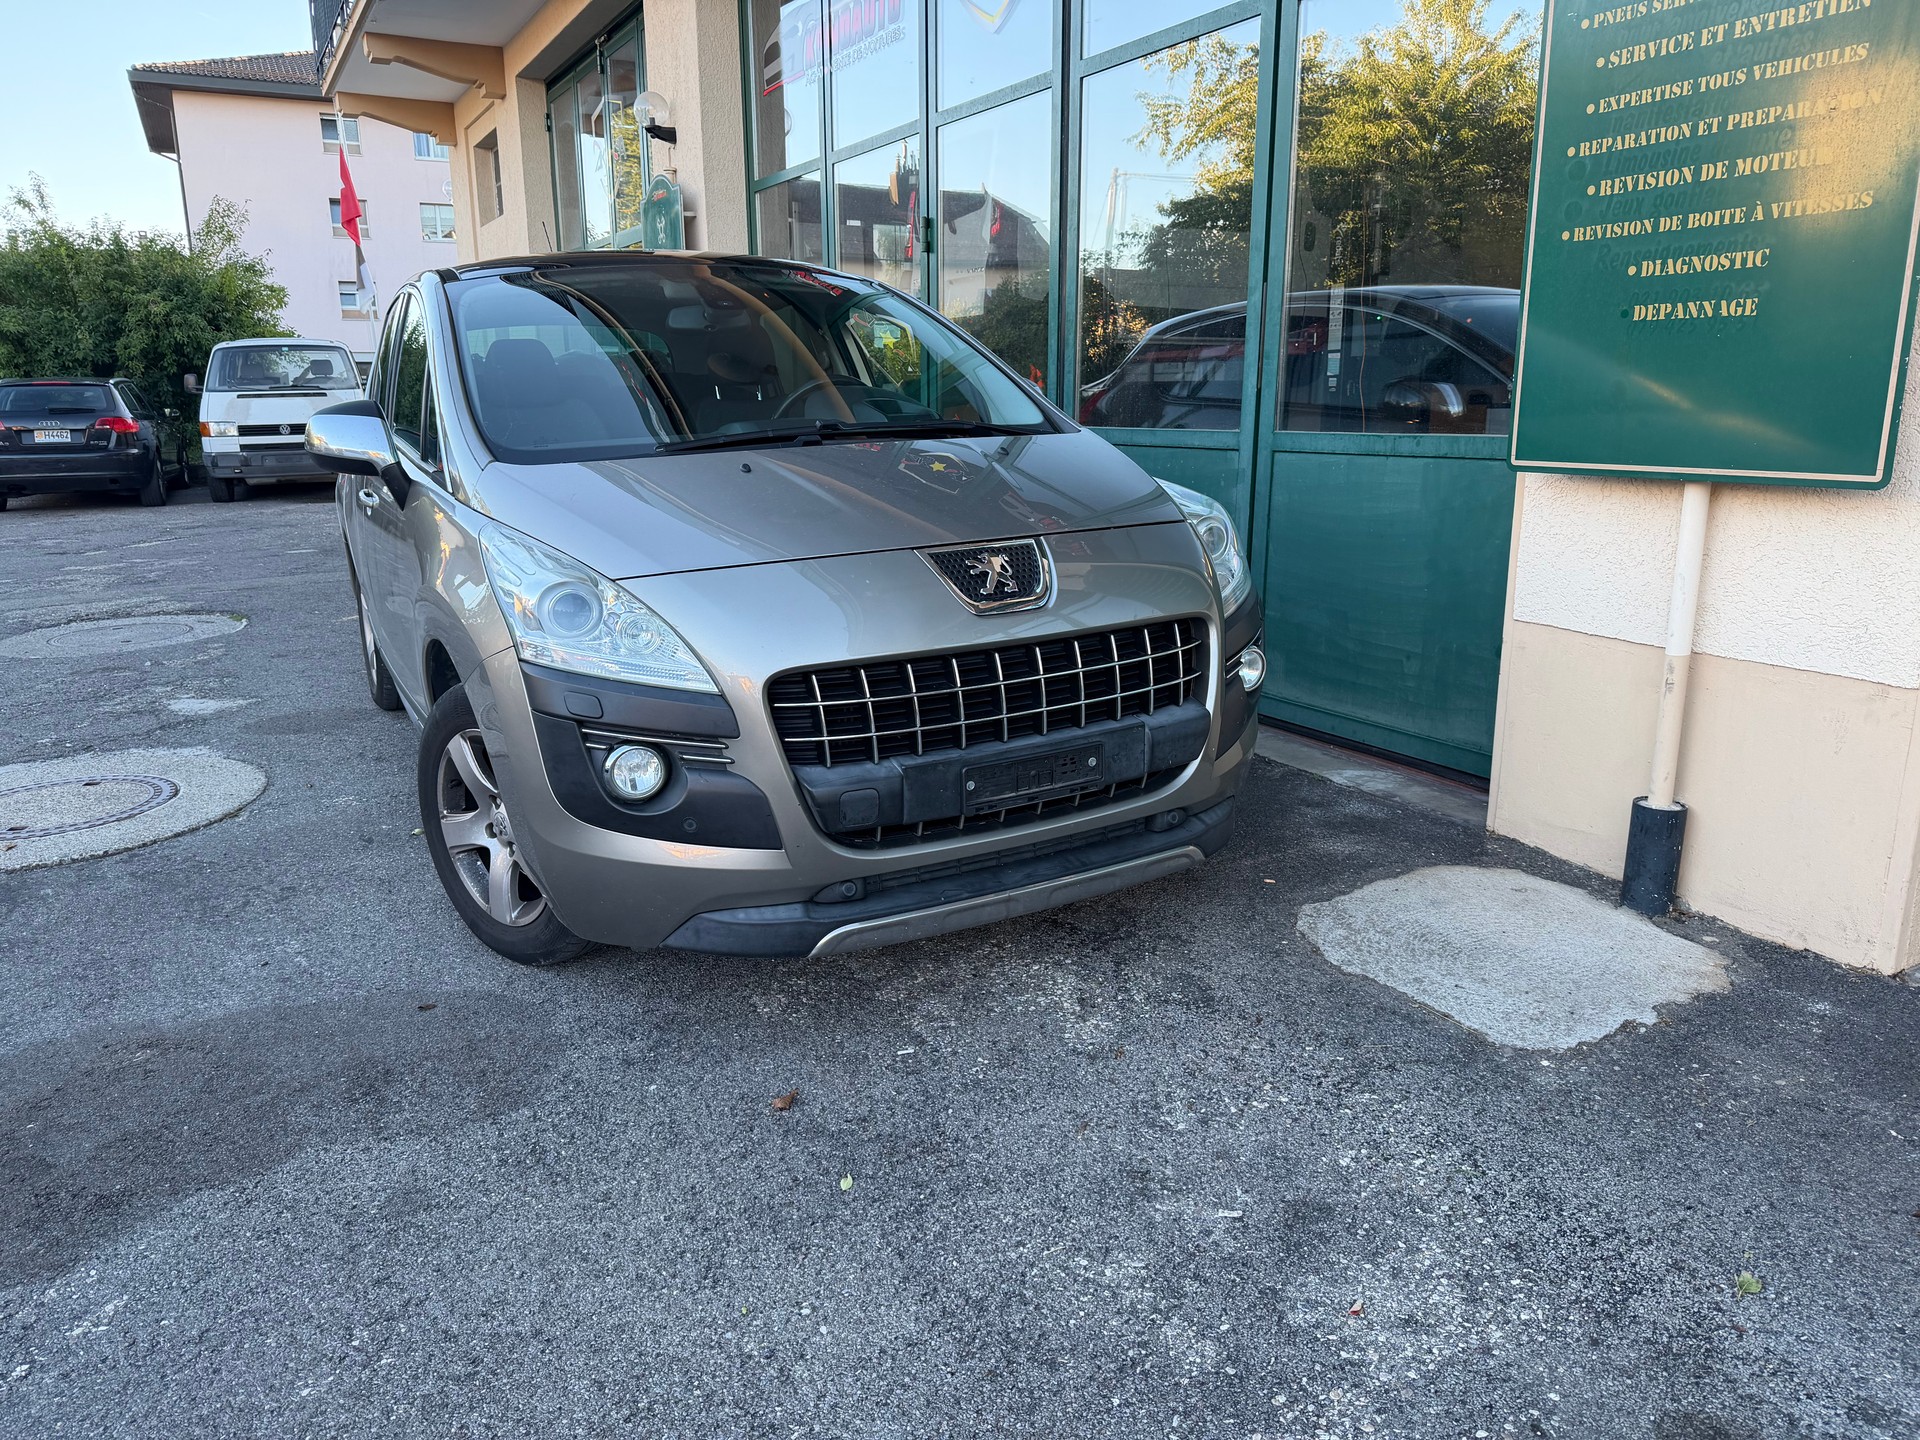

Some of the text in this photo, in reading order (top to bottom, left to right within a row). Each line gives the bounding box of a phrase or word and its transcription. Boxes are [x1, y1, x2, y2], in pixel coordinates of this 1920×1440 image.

[1593, 1, 1648, 28] PNEUS
[1608, 0, 1872, 68] SERVICE ET ENTRETIEN
[1598, 43, 1869, 114] EXPERTISE TOUS VEHICULES
[1579, 122, 1693, 157] REPARATION
[1697, 116, 1723, 136] ET
[1599, 166, 1695, 197] REVISION
[1700, 160, 1728, 182] DE
[1573, 191, 1874, 242] REVISION DE BOITE À VITESSES
[1640, 248, 1770, 278] DIAGNOSTIC
[44, 431, 69, 439] H4462
